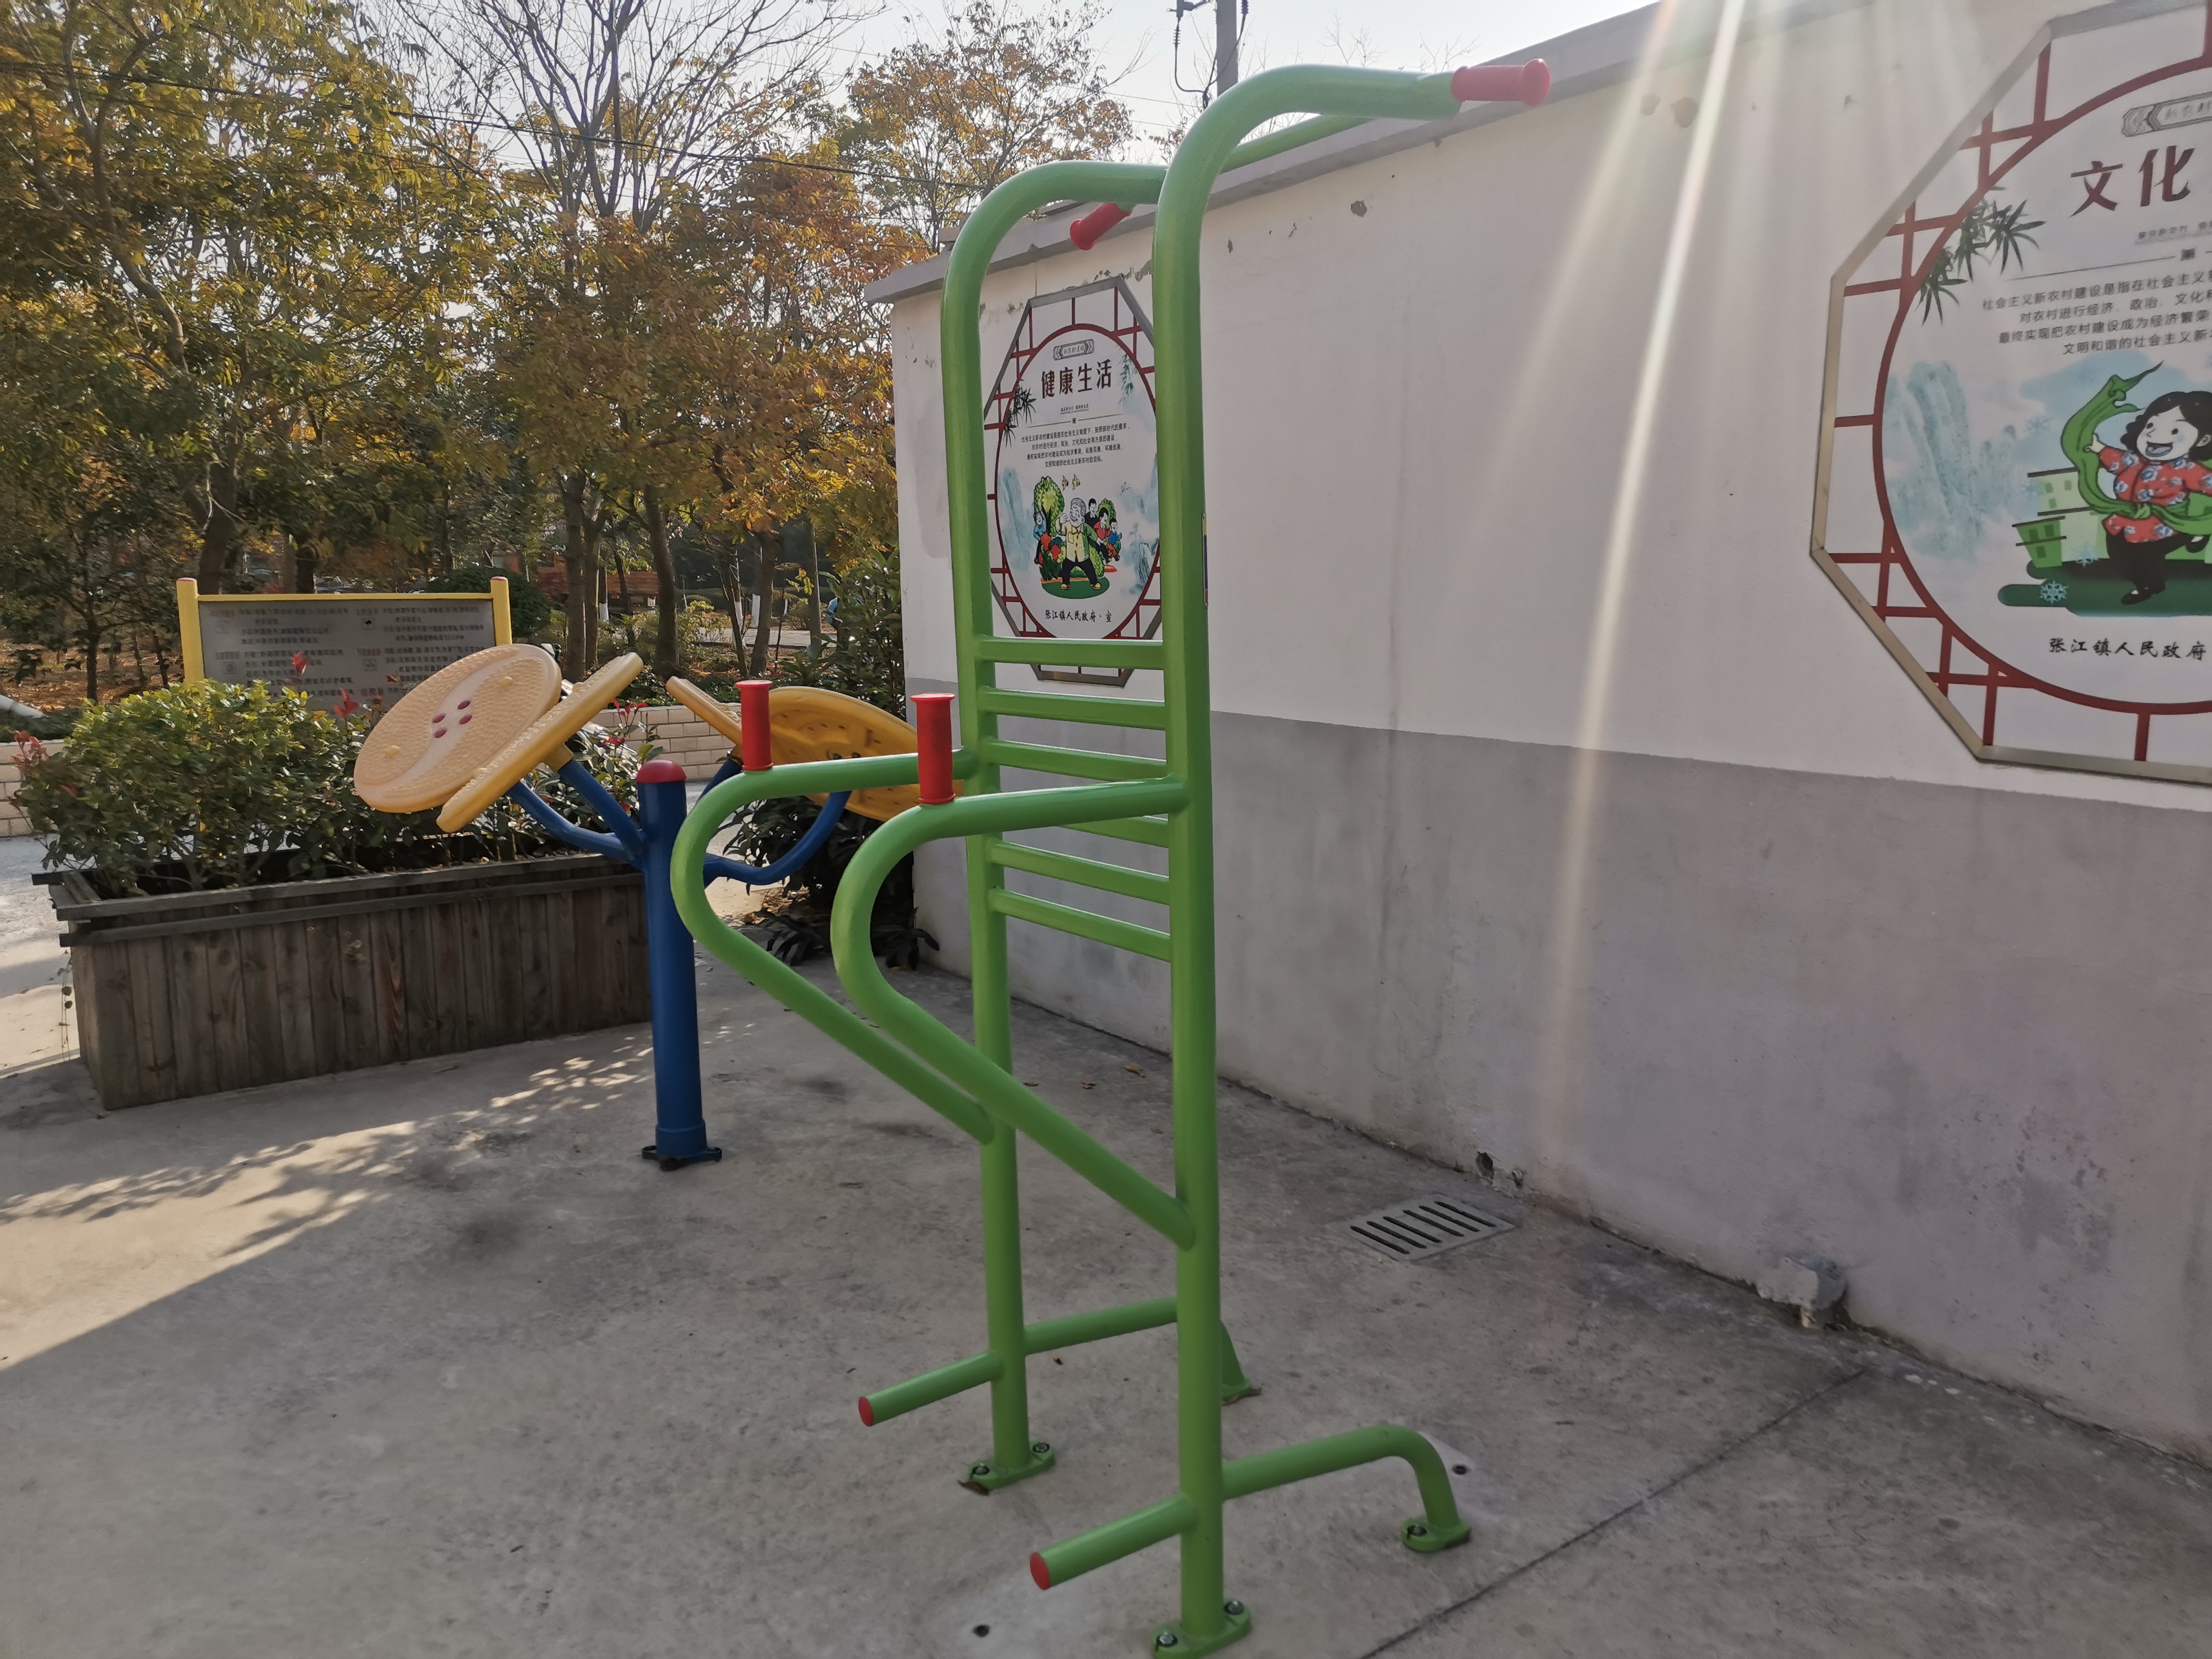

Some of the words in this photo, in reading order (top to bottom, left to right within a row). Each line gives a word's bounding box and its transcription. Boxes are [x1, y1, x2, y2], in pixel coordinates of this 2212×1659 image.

[2069, 145, 2195, 218] 文化
[2062, 329, 2212, 356] 文明和谐的社会主义新
[1041, 358, 1112, 399] 健康生活
[2049, 638, 2206, 661] 张江镇人民政府
